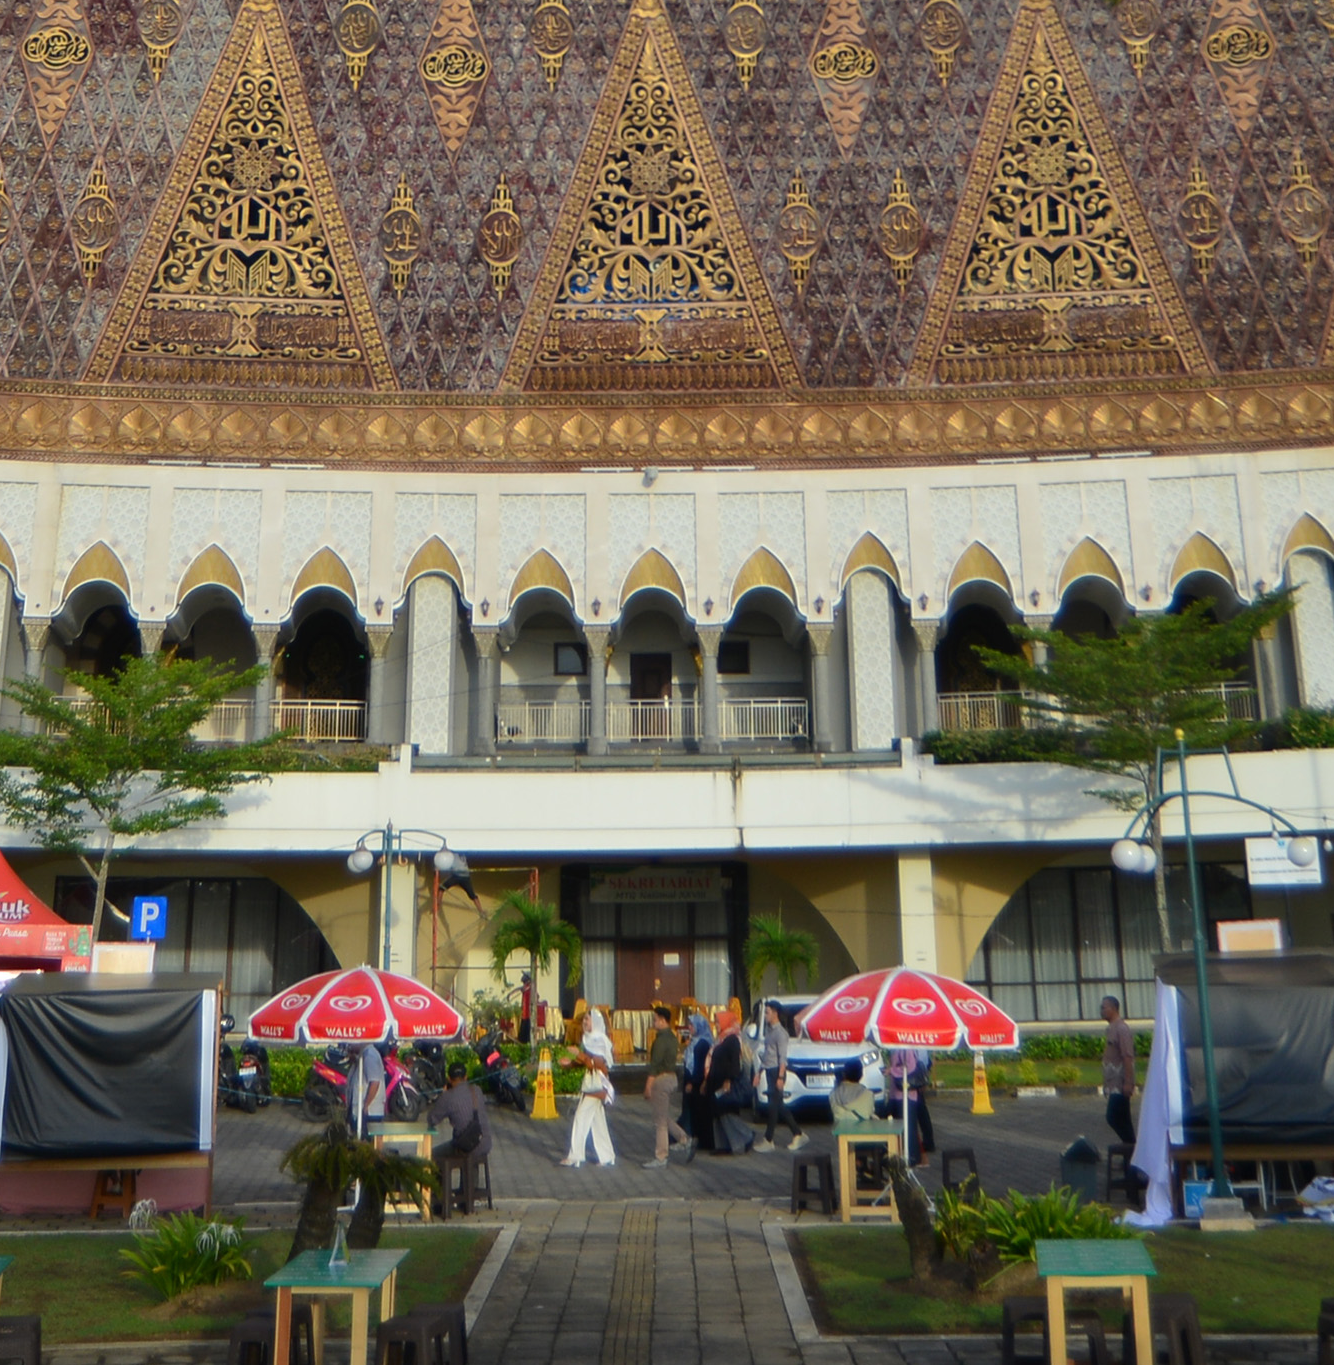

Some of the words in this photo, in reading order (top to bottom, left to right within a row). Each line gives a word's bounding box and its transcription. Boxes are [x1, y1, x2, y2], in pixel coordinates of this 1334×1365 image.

[609, 876, 711, 889] SEKRETARIAT
[140, 902, 160, 932] P
[325, 1027, 362, 1037] WALL'S
[413, 1024, 443, 1035] WALL'S
[819, 1030, 848, 1041] WALL'S
[897, 1032, 935, 1044] WALL'S
